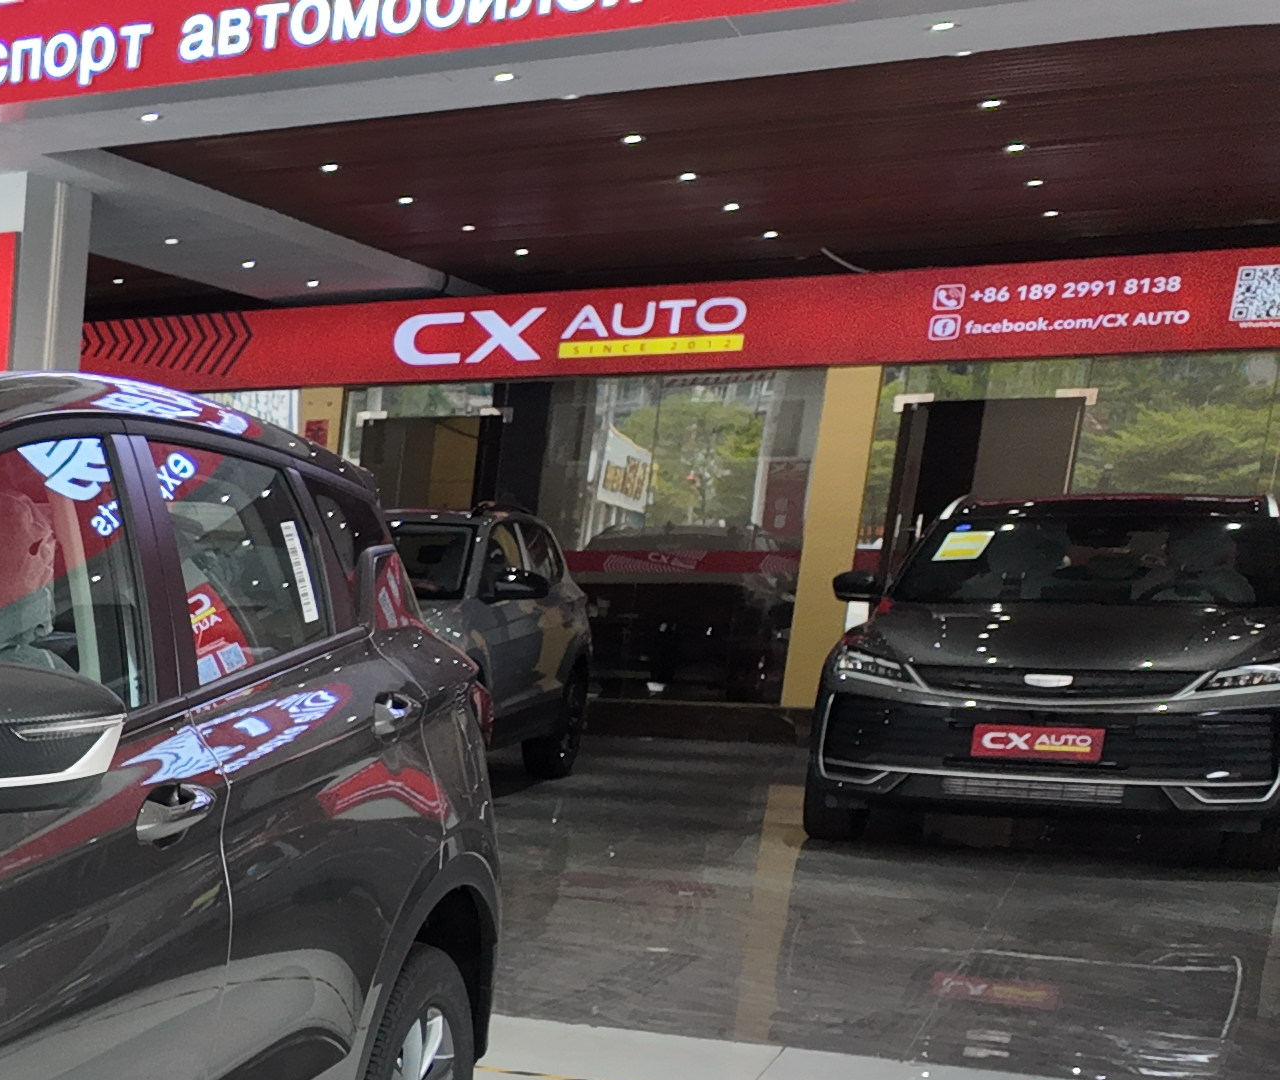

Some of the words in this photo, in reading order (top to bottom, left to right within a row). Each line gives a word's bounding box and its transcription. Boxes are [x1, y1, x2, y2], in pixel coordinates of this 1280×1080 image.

[970, 286, 1010, 303] +86
[1017, 283, 1057, 301] 189
[1062, 280, 1117, 298] 2991
[1124, 276, 1181, 295] 8138
[393, 307, 546, 366] CX
[561, 296, 747, 339] AUTO
[964, 313, 1130, 335] facebook.com/CX
[1133, 309, 1190, 326] AUTO
[572, 343, 647, 355] SINCE
[670, 339, 732, 351] 2012
[981, 731, 1032, 750] CX
[1034, 734, 1092, 746] AUTO
